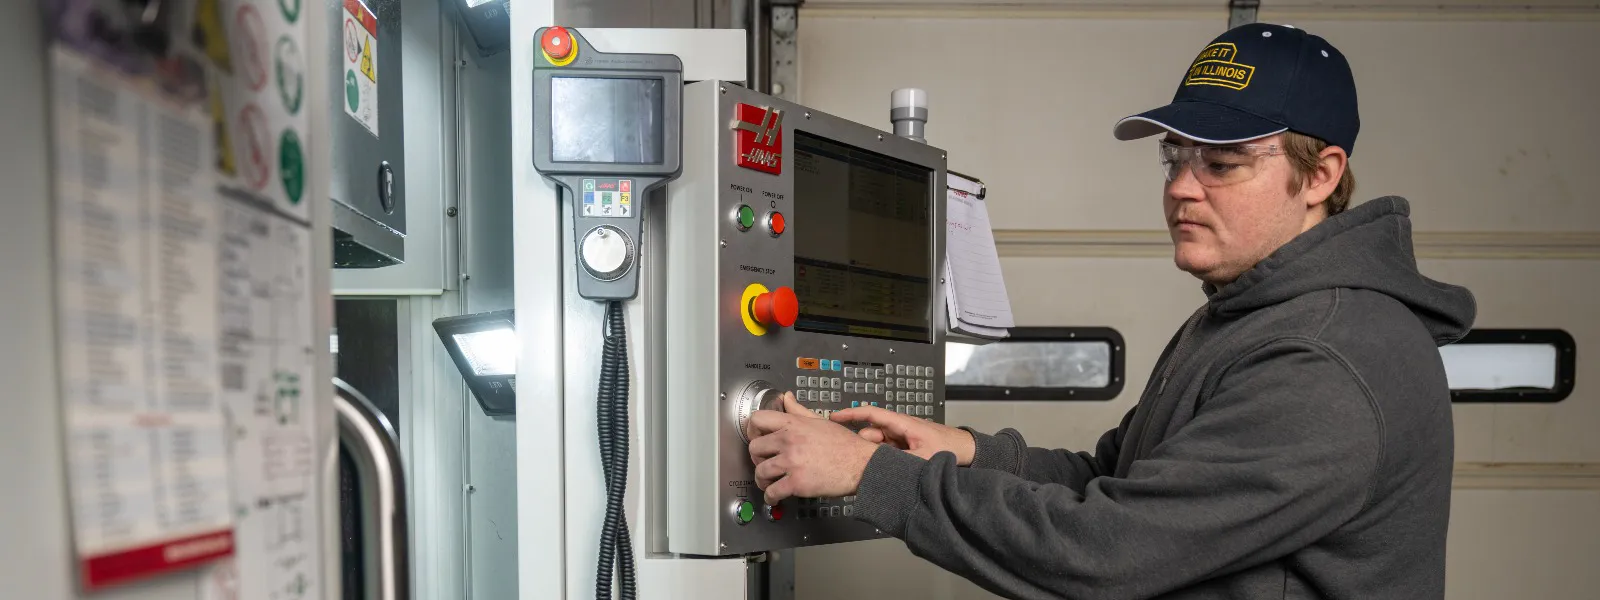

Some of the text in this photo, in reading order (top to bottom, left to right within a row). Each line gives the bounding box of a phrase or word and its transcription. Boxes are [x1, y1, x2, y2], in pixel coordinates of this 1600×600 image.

[1218, 47, 1231, 57] IT
[1192, 65, 1246, 80] IN ILLINOIS
[741, 147, 782, 168] HAAS
[730, 183, 746, 192] POWER
[762, 190, 785, 201] POWER OFF
[739, 264, 765, 274] EMERGENCY
